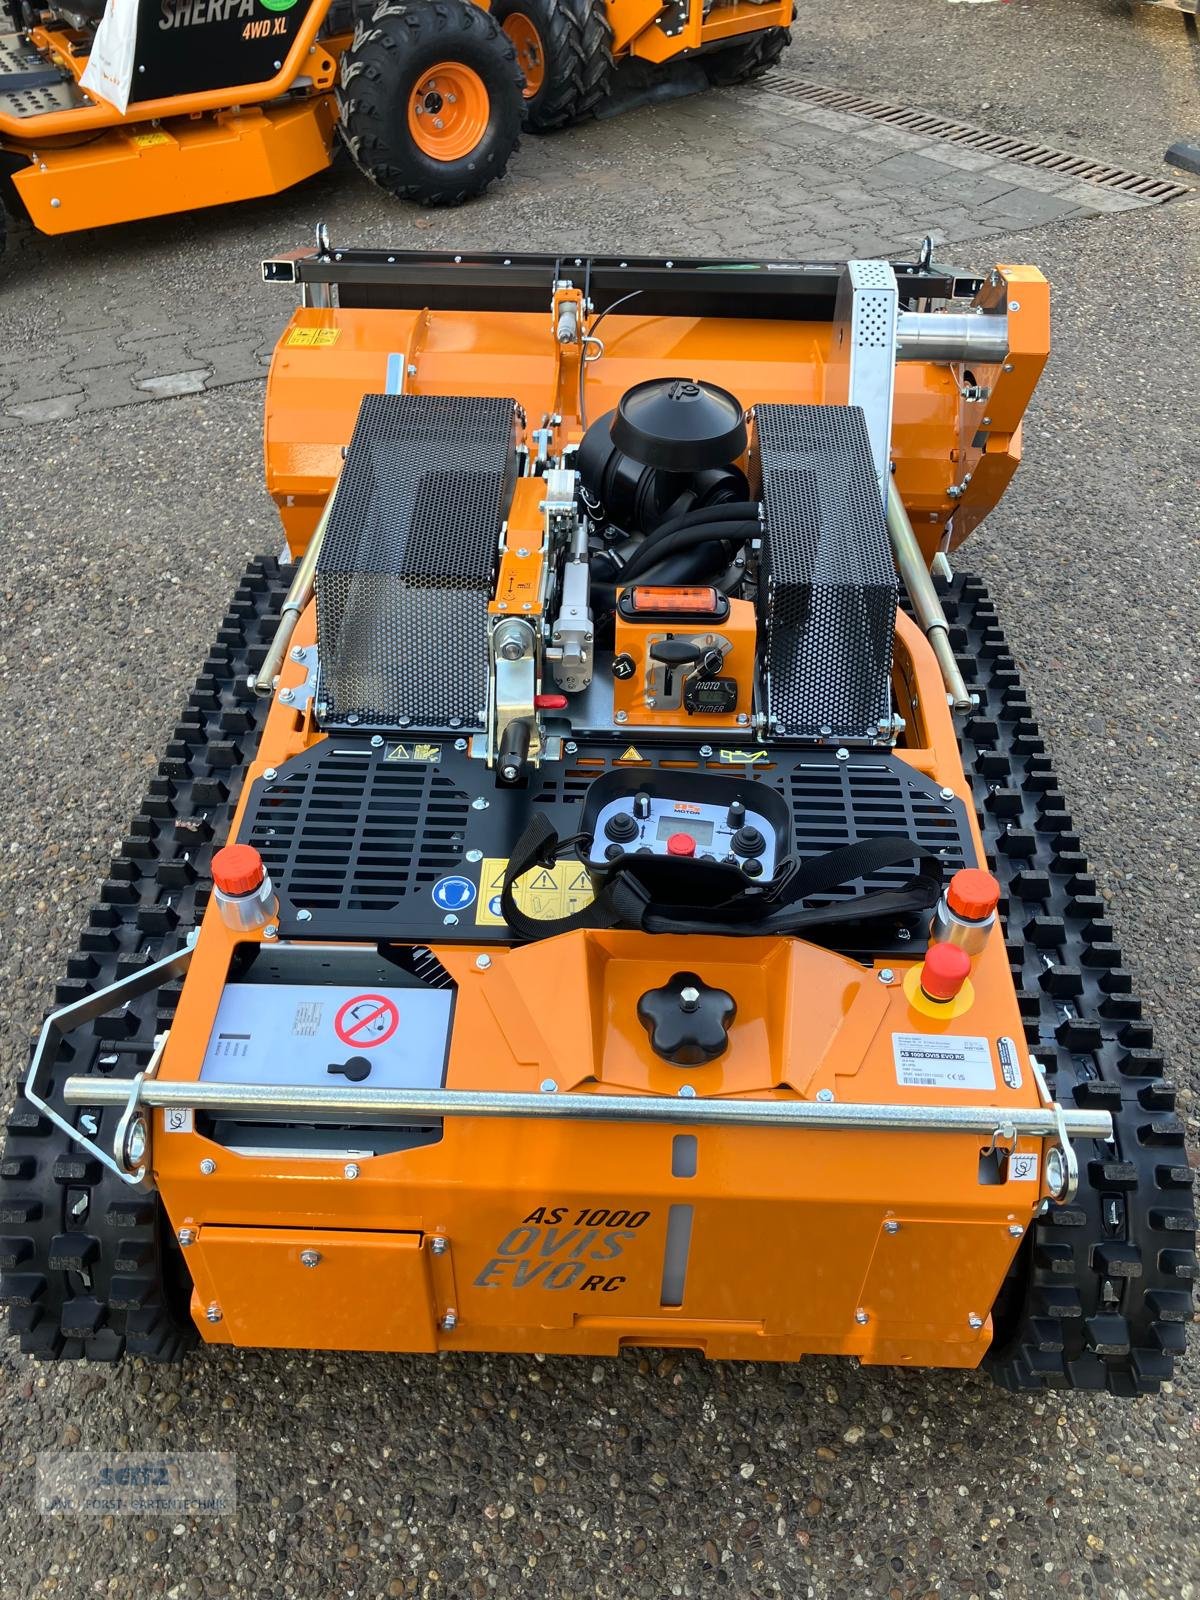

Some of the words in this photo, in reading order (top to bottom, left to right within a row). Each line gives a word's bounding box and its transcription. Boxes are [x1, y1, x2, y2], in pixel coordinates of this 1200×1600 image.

[158, 0, 254, 30] SHERPA
[242, 19, 271, 40] 4WD
[272, 17, 288, 35] XL
[695, 681, 721, 690] MOTO
[674, 808, 701, 816] MOTOR
[522, 1206, 569, 1225] AS
[573, 1208, 652, 1228] 1000
[496, 1226, 637, 1261] OVIS
[472, 1257, 587, 1291] EVO
[579, 1274, 627, 1292] RC
